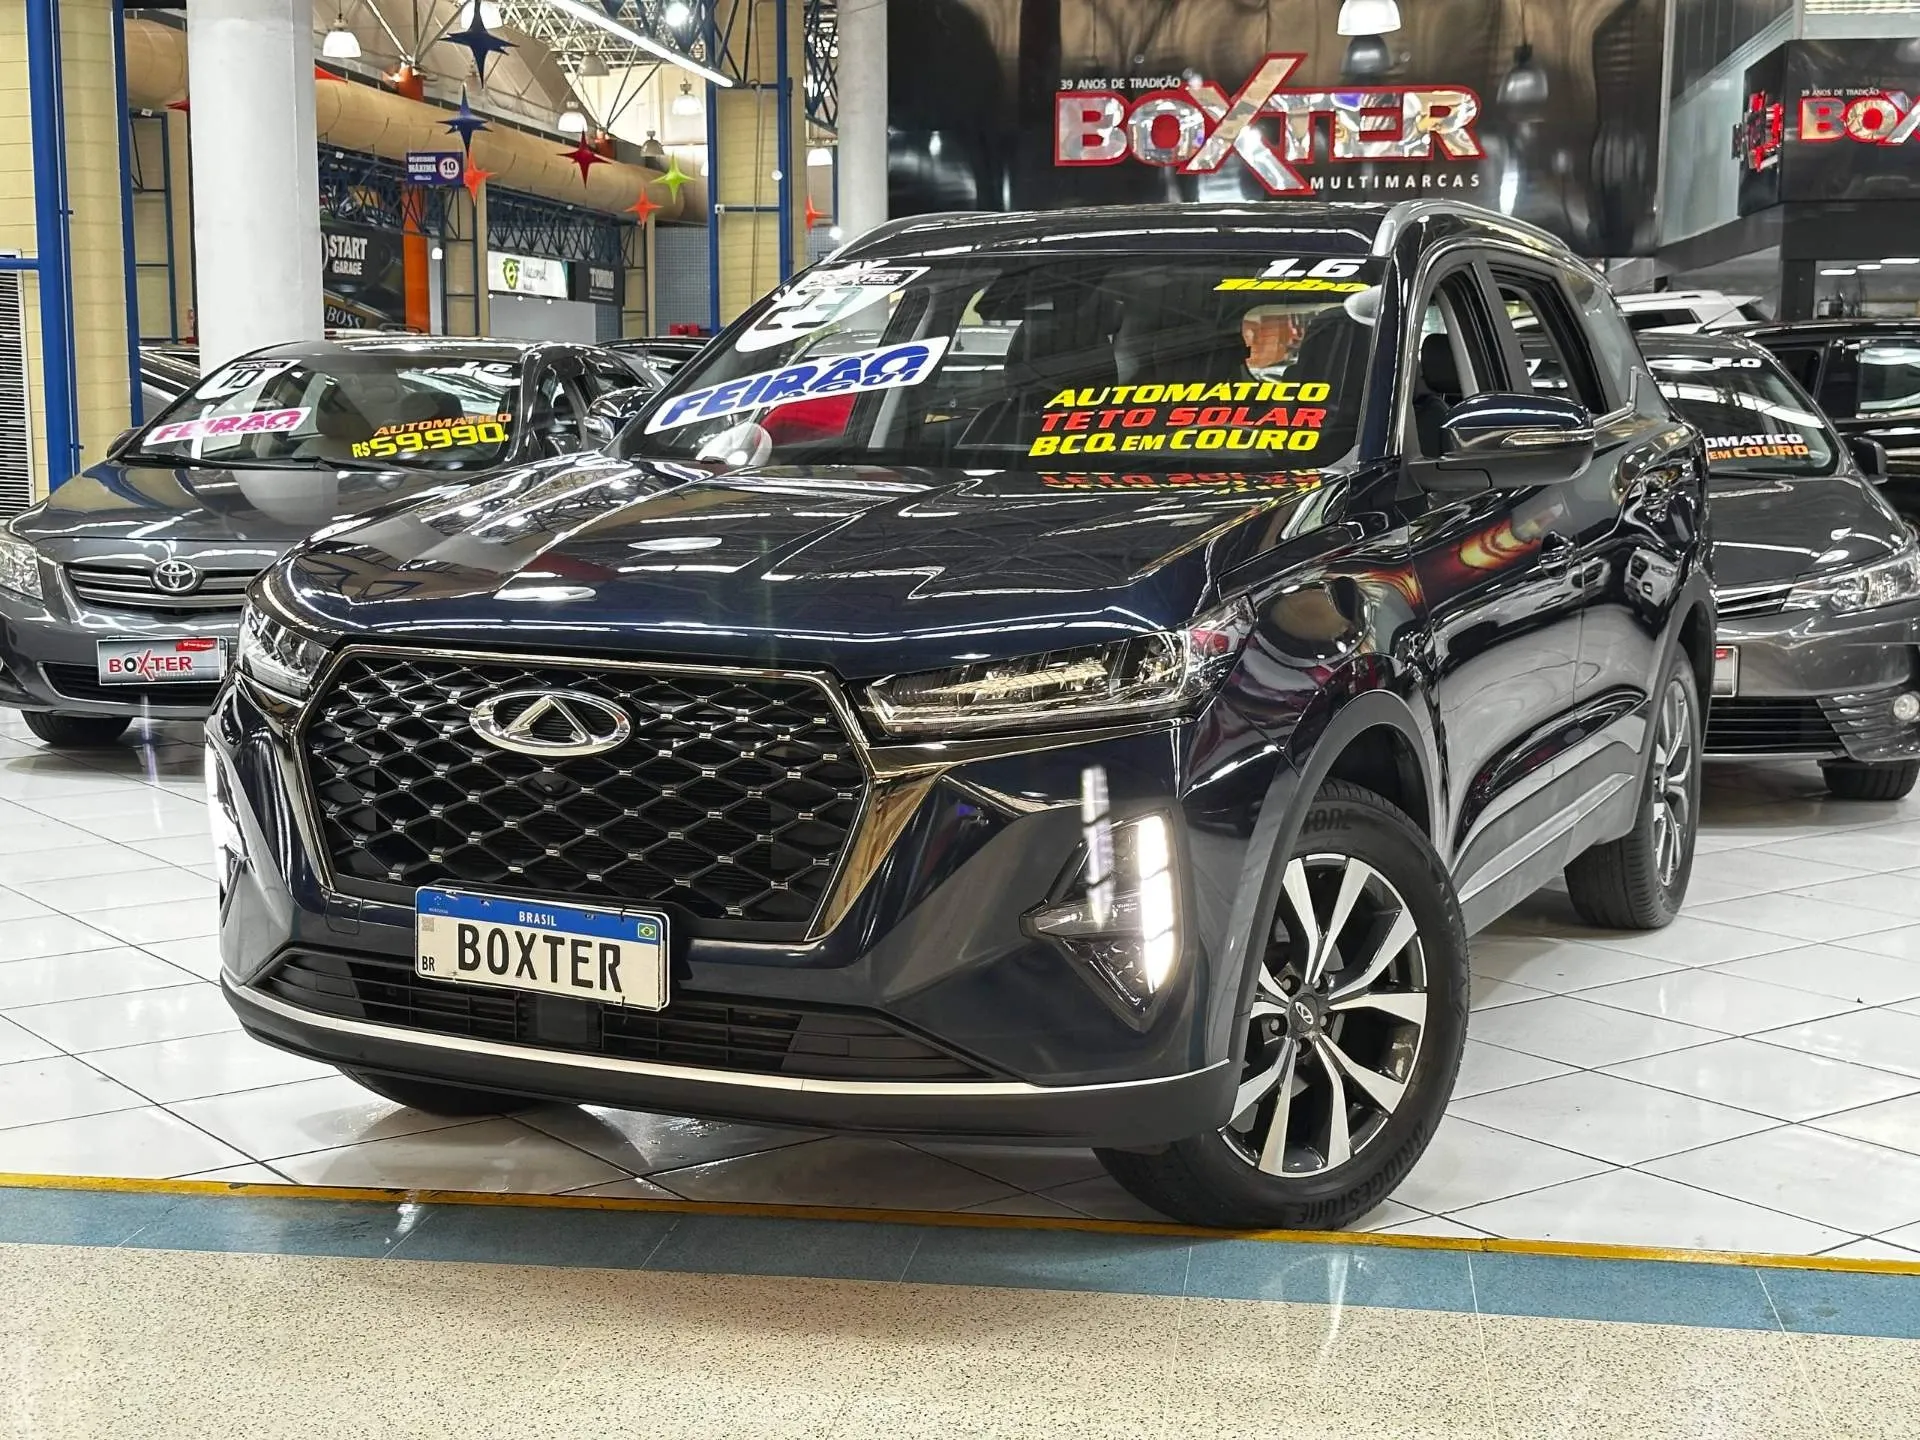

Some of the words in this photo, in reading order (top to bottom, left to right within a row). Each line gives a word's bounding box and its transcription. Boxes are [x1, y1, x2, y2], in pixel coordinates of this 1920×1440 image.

[1061, 79, 1073, 90] 39
[1077, 78, 1106, 90] ANOS
[1111, 78, 1125, 89] DE
[1129, 75, 1181, 90] TRADIÇÃO
[1812, 88, 1832, 98] ANOS
[1834, 88, 1844, 97] DE
[1846, 86, 1881, 98] TRADIÇÃO
[1055, 52, 1487, 195] BOXTER
[443, 161, 456, 171] 10
[1310, 173, 1481, 190] MULTIMARCAS
[329, 234, 368, 260] START
[332, 260, 362, 276] GARAGE
[1261, 258, 1367, 278] 1.6
[660, 345, 930, 426] FEIRÃO
[1043, 382, 1331, 409] AUTOMATICO
[1041, 408, 1158, 432] TETO
[1165, 406, 1328, 428] SOLAR
[1120, 434, 1167, 451] EM
[1169, 429, 1321, 451] COURO
[1709, 450, 1734, 461] EM
[1732, 443, 1809, 459] COURO
[108, 648, 194, 681] BOXTER
[518, 910, 558, 927] BRASIL
[421, 955, 436, 973] BR
[457, 922, 624, 994] BOXTER
